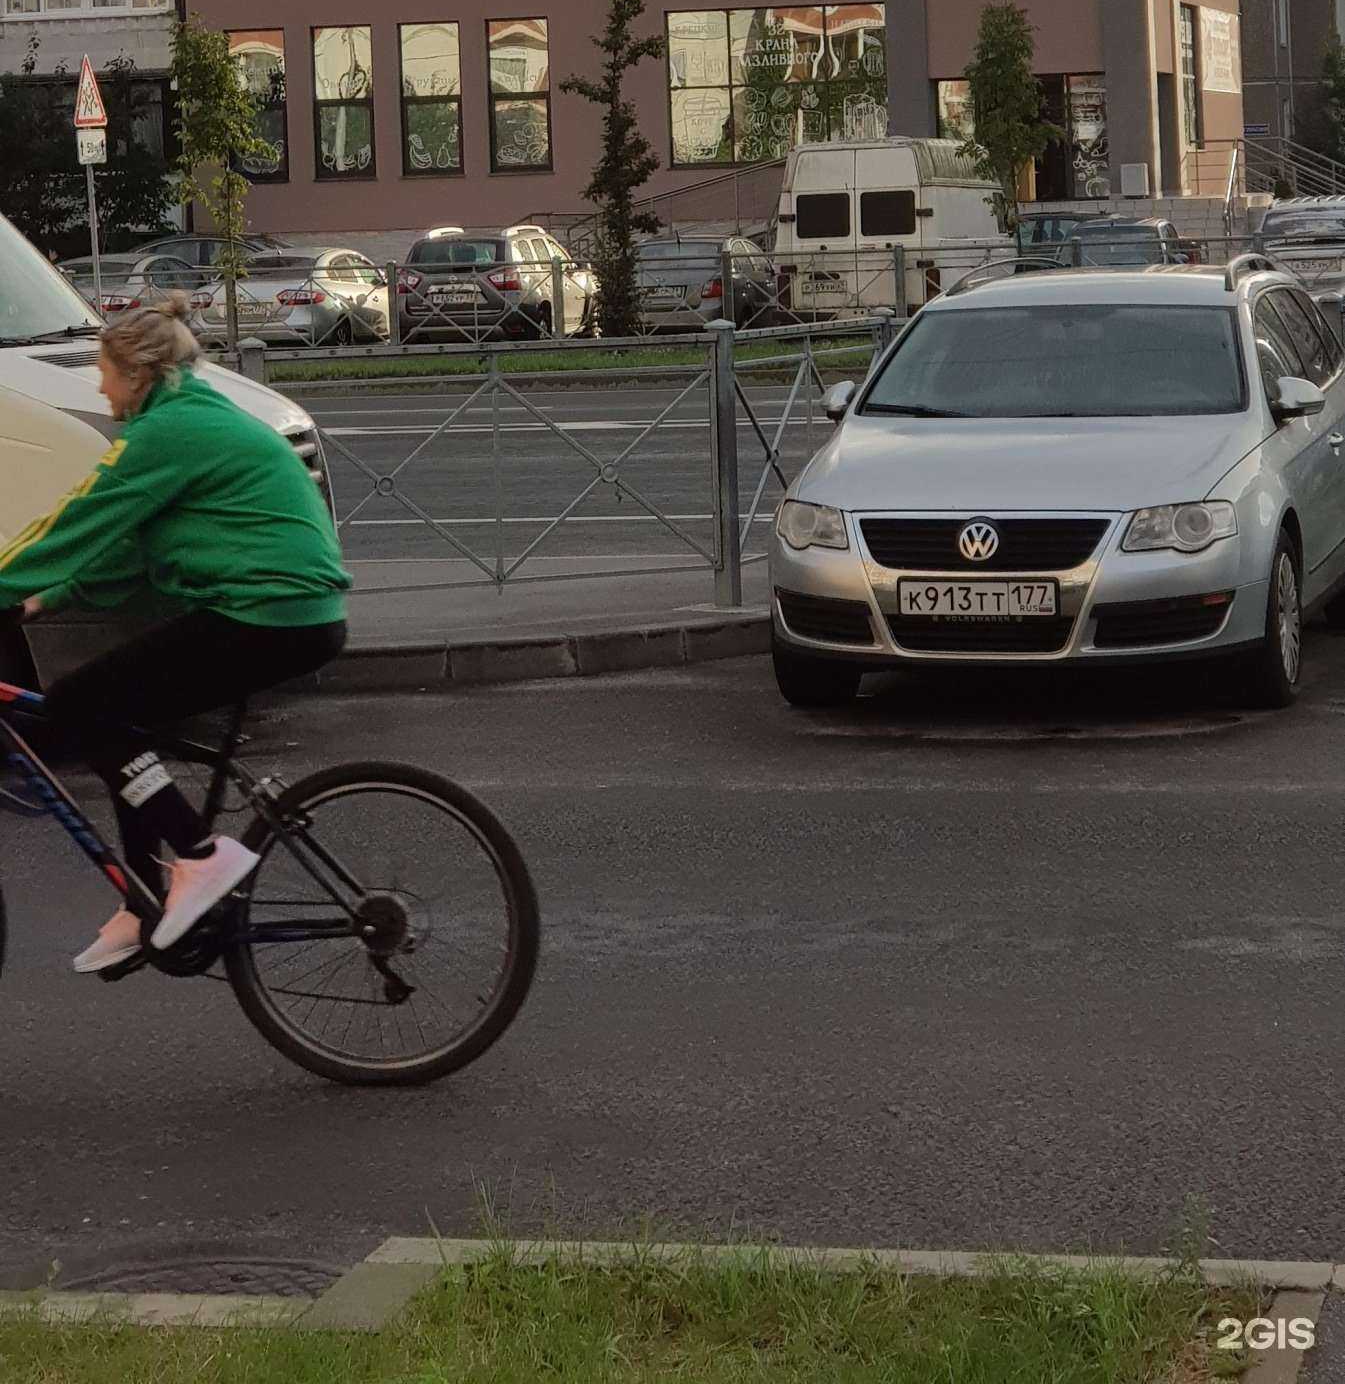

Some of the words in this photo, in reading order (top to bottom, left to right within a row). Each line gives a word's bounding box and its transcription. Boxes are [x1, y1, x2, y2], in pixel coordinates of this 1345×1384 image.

[755, 38, 799, 52] КРАНА
[909, 586, 1005, 612] К913ТТ
[1011, 585, 1048, 605] 177
[1019, 604, 1038, 613] RUS
